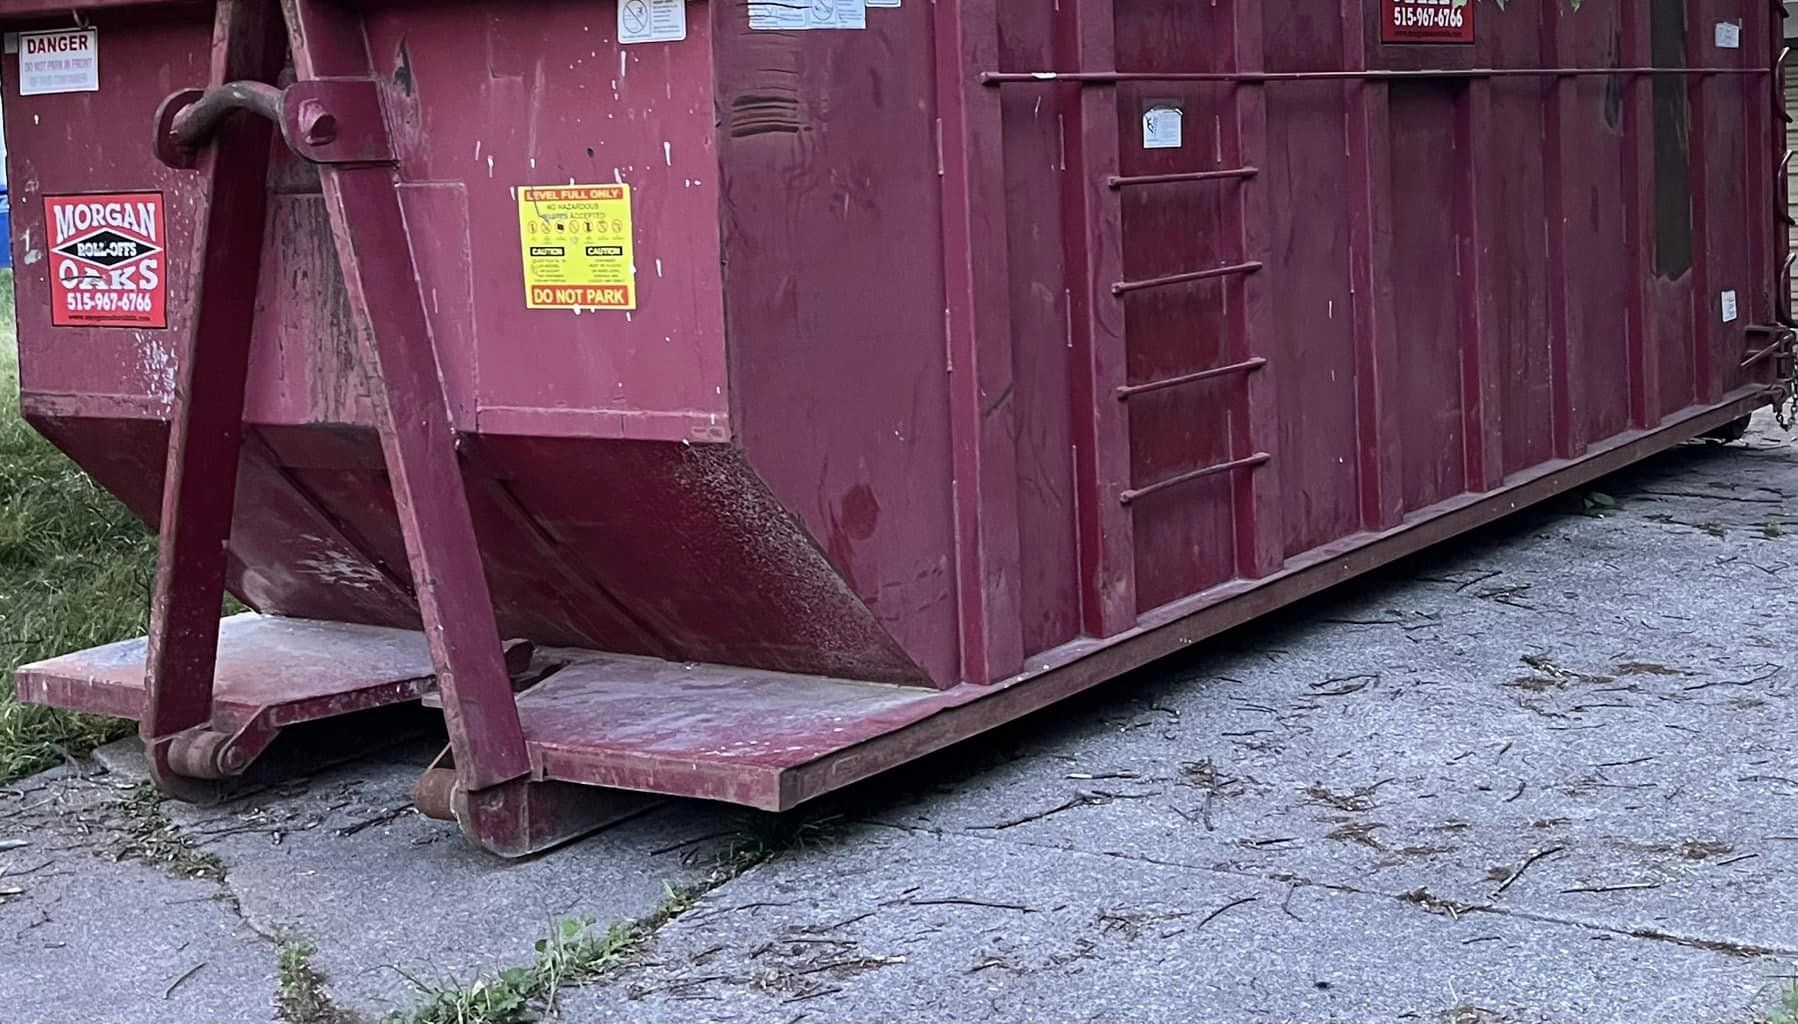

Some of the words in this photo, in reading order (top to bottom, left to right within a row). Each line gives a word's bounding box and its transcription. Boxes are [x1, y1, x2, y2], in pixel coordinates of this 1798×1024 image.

[1394, 7, 1463, 27] 515-967-6766
[27, 35, 88, 54] DANGER
[526, 190, 559, 201] LEVEL
[561, 190, 589, 200] FULL
[53, 202, 156, 244] MORGAN
[77, 241, 137, 257] ROLL-OFFS
[58, 259, 158, 290] OAKS
[67, 292, 152, 312] 515-967-6766
[533, 289, 553, 303] DO
[556, 289, 583, 304] NOT
[586, 289, 625, 304] PARK
